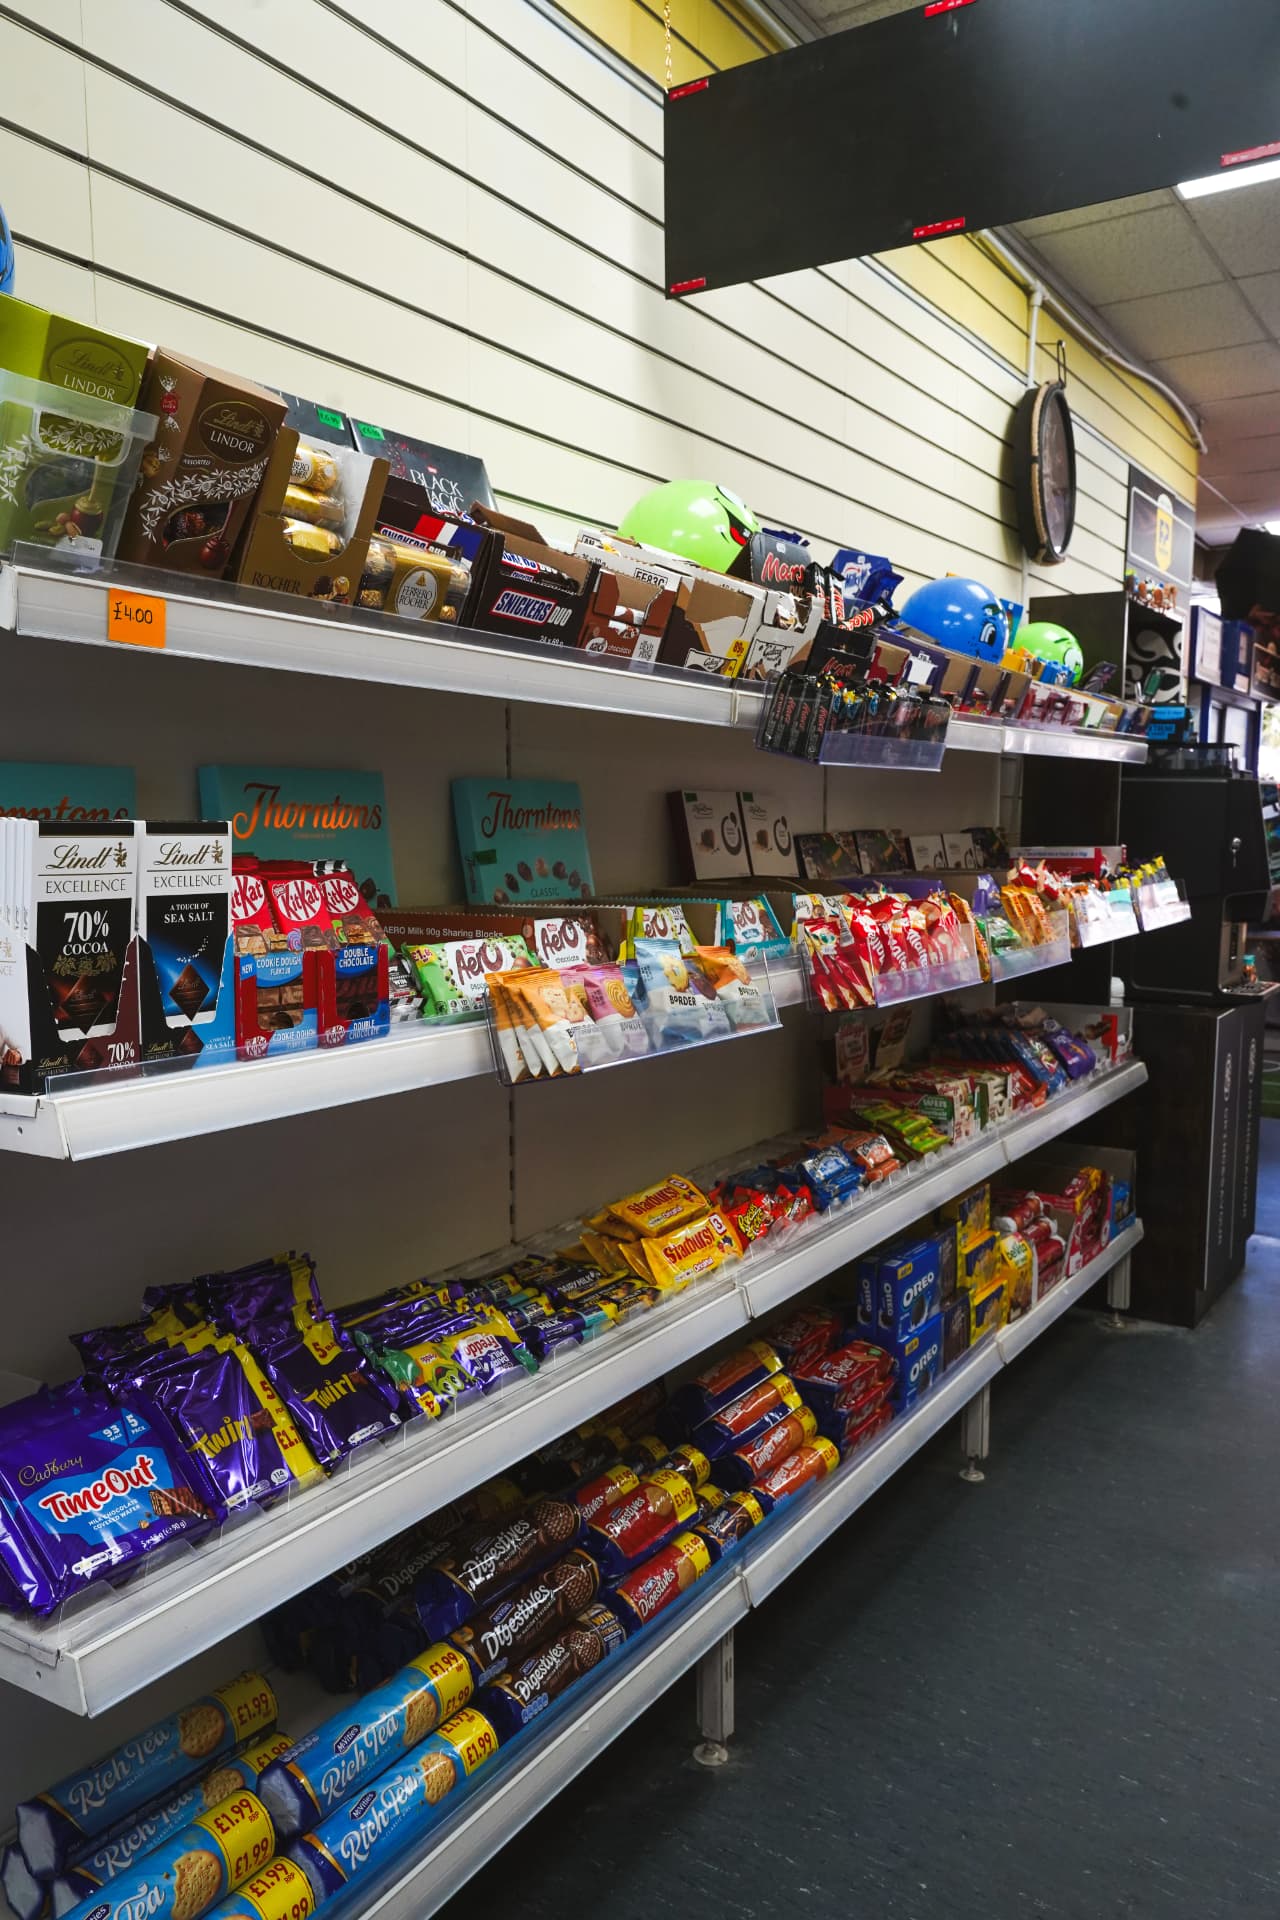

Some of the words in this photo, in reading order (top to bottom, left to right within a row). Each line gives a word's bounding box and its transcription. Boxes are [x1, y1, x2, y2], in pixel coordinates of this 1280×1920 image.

[63, 374, 115, 400] LINDOR
[210, 430, 255, 453] LINDOR
[410, 468, 463, 497] BLACK
[761, 552, 805, 583] Mars
[399, 596, 428, 609] ROCHER
[402, 585, 433, 599] FERRERO
[113, 602, 153, 624] £4.00
[495, 591, 556, 623] SNICKERS
[547, 606, 573, 627] DUO
[232, 782, 383, 840] Thorntons
[481, 791, 582, 839] Thorntons
[45, 844, 113, 870] Lindt
[153, 842, 210, 866] Lindt
[46, 878, 126, 894] EXCELLENCE
[153, 875, 223, 889] EXCELLENCE
[176, 903, 200, 911] TOUCH
[200, 902, 210, 910] OF
[283, 880, 320, 921] KitKat
[63, 909, 109, 943] 70%
[163, 913, 186, 924] SEA
[188, 911, 215, 923] SALT
[383, 926, 405, 934] AERO
[408, 926, 424, 935] Milk
[426, 928, 440, 938] 90g
[442, 928, 473, 938] Sharing
[475, 929, 504, 938] Blocks
[62, 942, 109, 956] COCOA
[343, 948, 369, 958] DOUBLE
[541, 919, 580, 958] Aero
[242, 964, 254, 975] NEW
[256, 957, 280, 968] COOKIE
[280, 956, 301, 967] DOUGH
[338, 956, 375, 969] CHOCOLATE
[456, 941, 503, 986] Aero
[669, 994, 697, 1007] BORDER
[107, 1042, 135, 1063] 70%
[627, 1186, 680, 1216] Starburst
[713, 1218, 723, 1231] 3
[662, 1225, 716, 1266] Starburst
[576, 1274, 595, 1286] MILK
[903, 1272, 935, 1308] OREO
[883, 1282, 894, 1317] OREO
[910, 1343, 938, 1384] OREO
[303, 1374, 357, 1410] Twirl
[102, 1425, 121, 1438] 93
[126, 1414, 139, 1427] 5
[187, 1415, 254, 1459] Twirl
[18, 1455, 84, 1487] Cadbury
[754, 1444, 776, 1469] Ginger
[120, 1504, 140, 1519] WAFER
[674, 1487, 692, 1508] £1.99
[604, 1495, 646, 1540] Digestives
[463, 1518, 532, 1588] Digestives
[637, 1567, 677, 1618] Digestives
[480, 1584, 552, 1662] Digestives
[592, 1610, 616, 1625] WIN
[430, 1651, 459, 1677] £1.99
[514, 1642, 566, 1702] Digestives
[237, 1692, 269, 1726] £1.99
[321, 1744, 368, 1806] Rich
[362, 1713, 399, 1757] Tea
[466, 1731, 493, 1767] £1.99
[69, 1758, 131, 1816] Rich
[125, 1726, 171, 1764] Tea
[214, 1798, 254, 1836] £1.99
[340, 1801, 391, 1870] Rich
[380, 1771, 420, 1816] Tea
[95, 1822, 155, 1878] Rich
[235, 1837, 269, 1880] £1.99
[249, 1863, 289, 1899] £1.99
